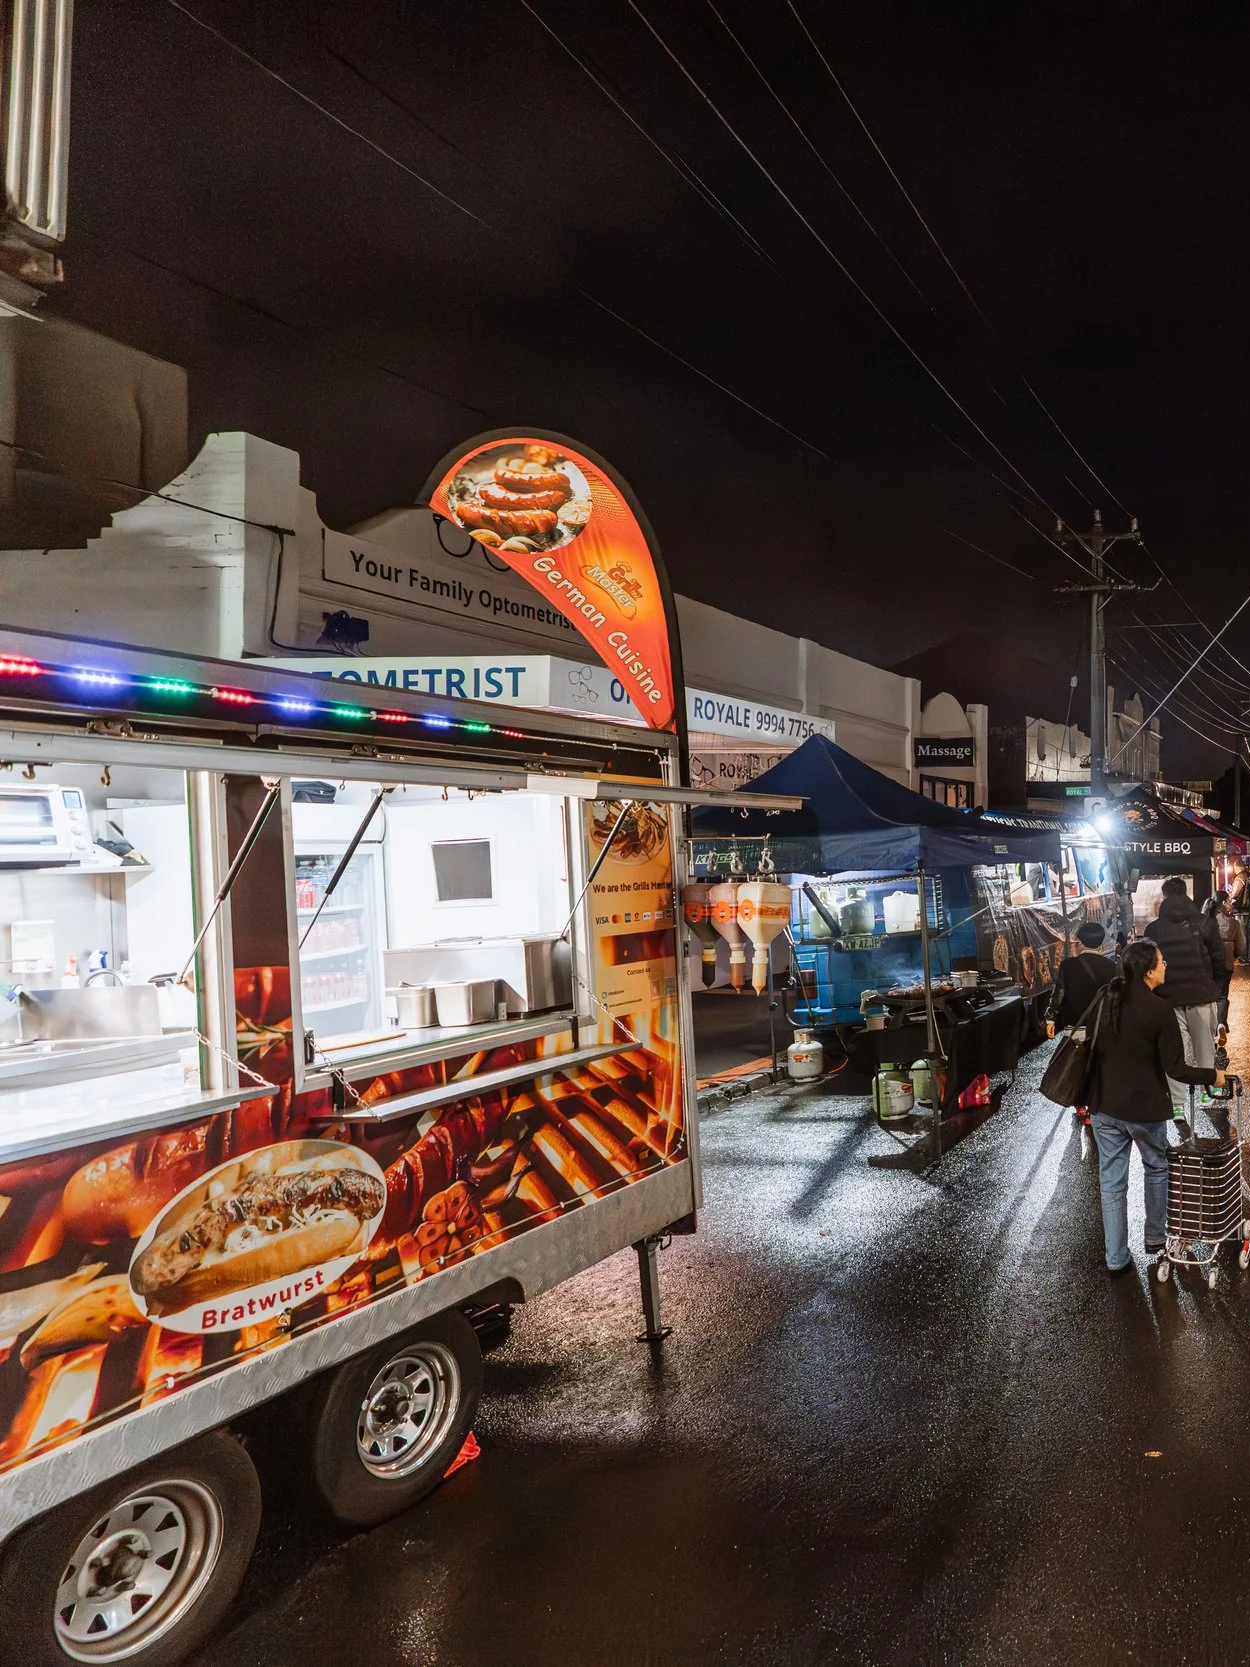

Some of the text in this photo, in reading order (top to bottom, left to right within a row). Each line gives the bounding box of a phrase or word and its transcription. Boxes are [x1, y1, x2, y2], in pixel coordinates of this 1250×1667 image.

[350, 550, 403, 584] Your
[409, 568, 474, 607] Family
[586, 565, 636, 609] Master
[533, 557, 662, 704] German Cuisine
[694, 696, 815, 739] ROYALE 9994 7756
[917, 745, 971, 759] Massage
[1123, 841, 1191, 854] STYLE BBQ
[593, 884, 606, 893] We
[607, 885, 619, 893] are
[620, 883, 632, 891] the
[595, 916, 609, 925] VISA
[627, 967, 644, 976] Contact
[201, 1270, 324, 1330] Bratwurst
